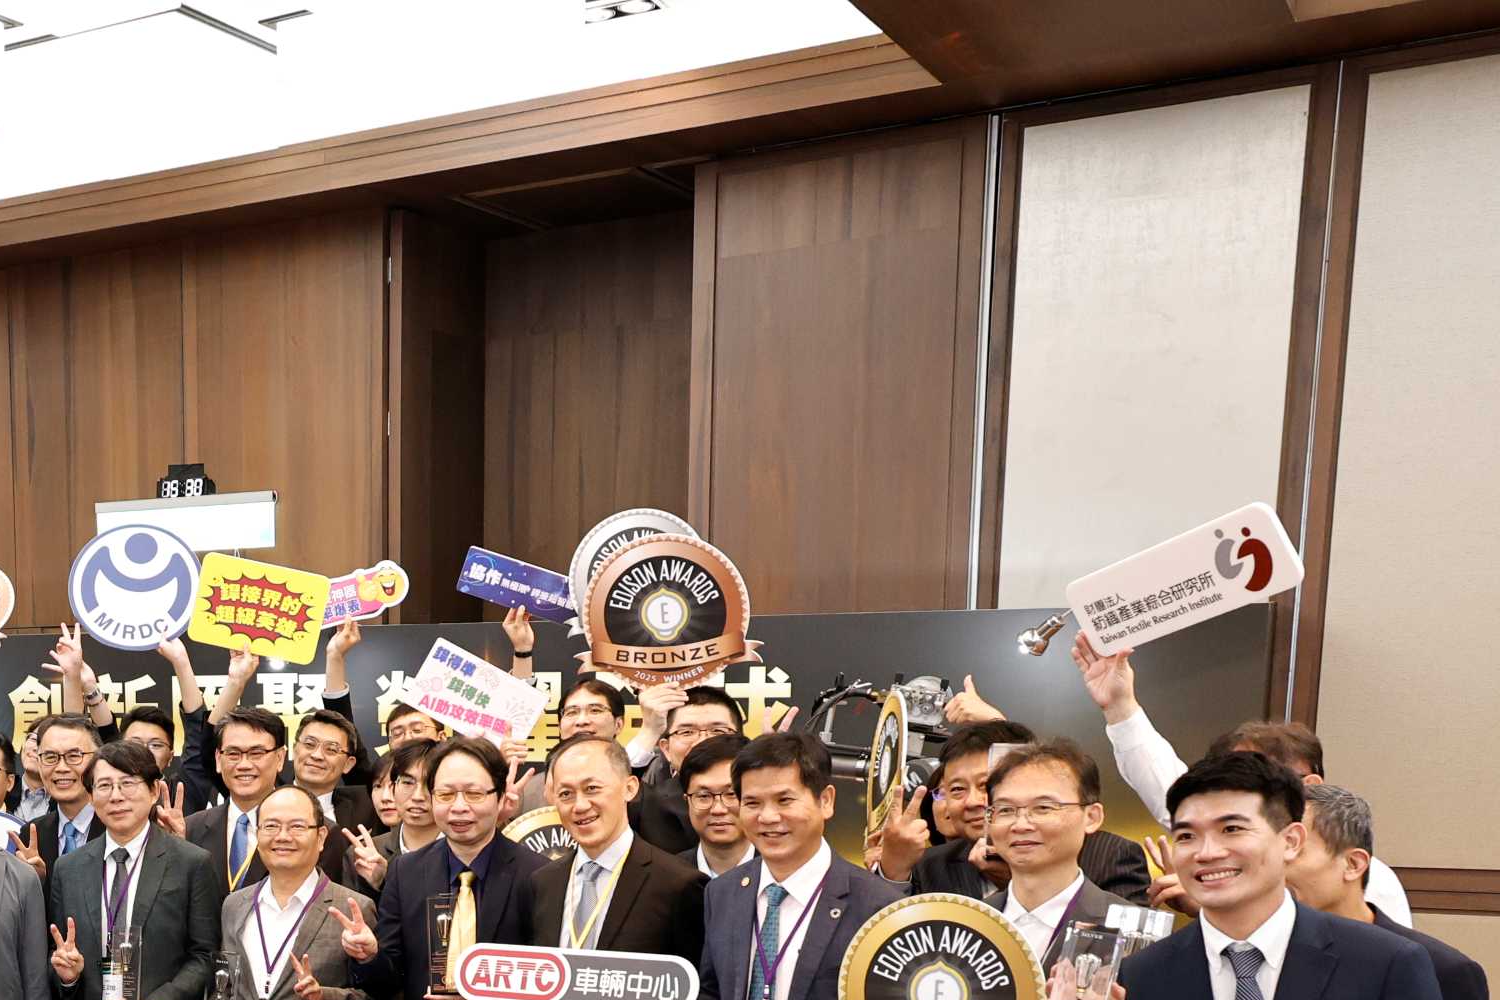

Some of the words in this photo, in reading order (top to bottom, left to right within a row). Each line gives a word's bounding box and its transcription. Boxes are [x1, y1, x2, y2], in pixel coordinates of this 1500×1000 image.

[610, 561, 659, 610] EDISON
[659, 559, 719, 605] AWARDS
[1091, 570, 1217, 632] 紡織產業綜合研究所
[94, 611, 169, 640] MIRDC
[1100, 629, 1127, 645] Taiwan
[1127, 619, 1151, 635] Textile
[1152, 605, 1189, 625] Research
[1188, 592, 1224, 611] Institute
[616, 643, 721, 664] BRONZE
[634, 670, 657, 682] 2025
[663, 666, 704, 683] WINNER
[470, 958, 556, 993] ARTC
[572, 966, 680, 1000] 車輛中心
[873, 924, 936, 983] EDISON
[937, 926, 1010, 991] AWARDS
